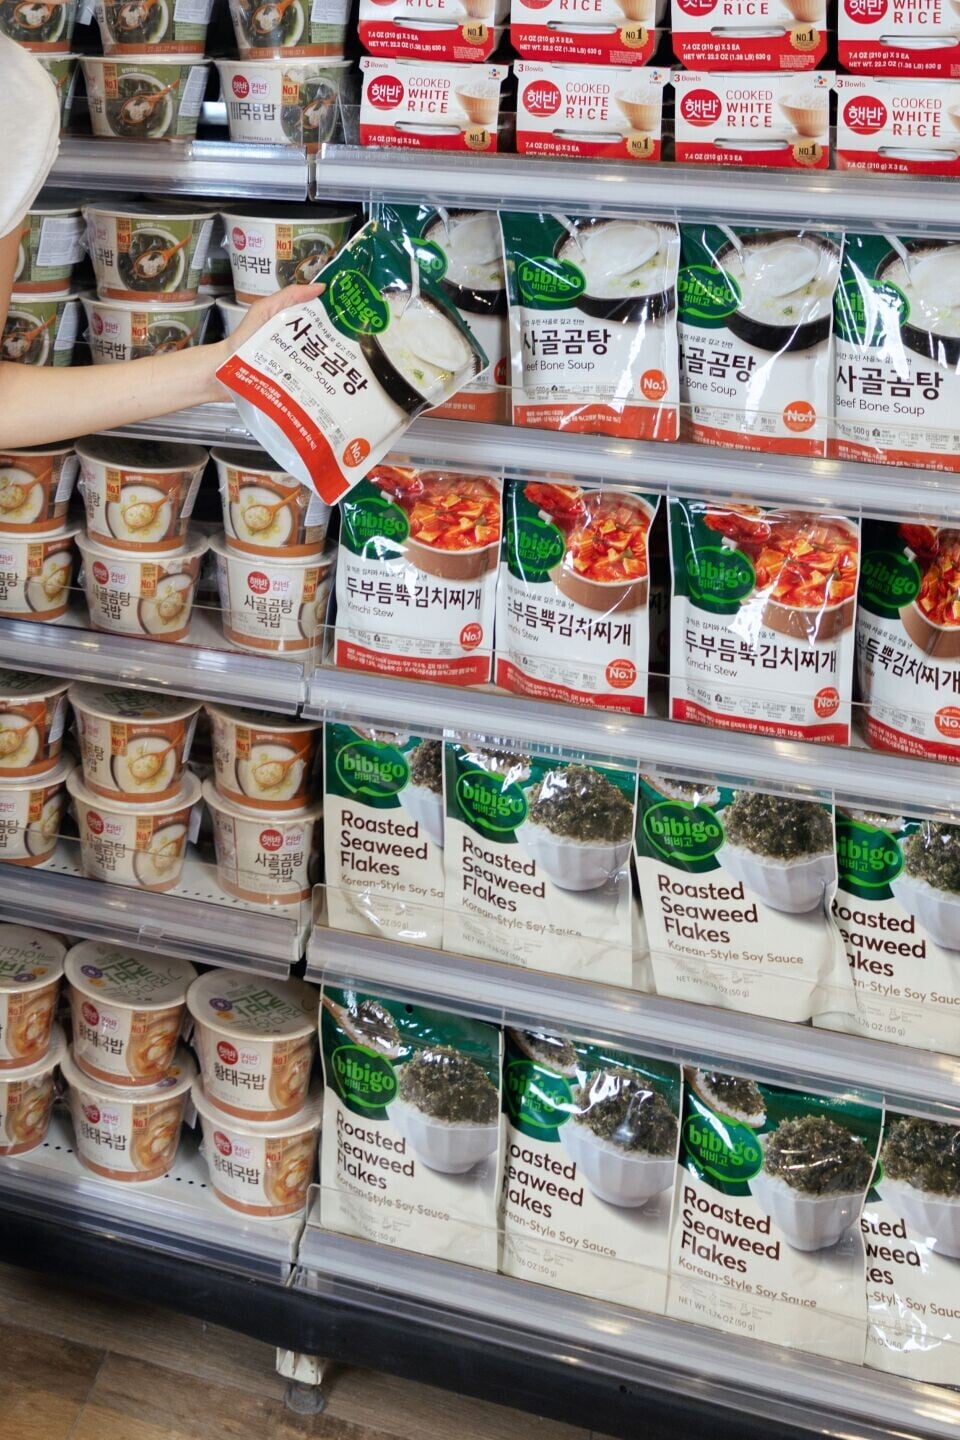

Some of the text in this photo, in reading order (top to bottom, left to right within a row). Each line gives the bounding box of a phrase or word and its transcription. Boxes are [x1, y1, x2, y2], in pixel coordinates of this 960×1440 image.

[724, 3, 768, 15] RICE
[522, 268, 581, 292] bibigo
[531, 282, 557, 293] 비비고
[339, 292, 358, 318] 비비고
[340, 274, 383, 328] bibigo
[286, 316, 368, 396] 사골곰탕
[524, 329, 611, 356] 사골곰탕
[270, 332, 337, 396] Beef Bone Soup
[524, 360, 595, 372] eef Bone Soup
[643, 378, 666, 392] No.1
[688, 379, 737, 396] Bone Soup
[837, 364, 944, 400] 사골곰탕
[859, 399, 890, 414] Bone
[893, 402, 926, 418] Soup
[688, 558, 750, 588] bibigo
[862, 560, 916, 596] bibigo
[244, 595, 294, 614] 사골곰탕
[346, 576, 481, 610] 두부듬뿍김치찌개
[347, 602, 394, 618] Kimchi Stew
[508, 597, 632, 646] 부듬뿍김치찌개
[463, 631, 481, 642] No.1
[685, 629, 838, 674] 두부듬뿍김치찌개
[609, 668, 634, 680] No.1
[686, 656, 738, 678] Kimchi Stew
[344, 754, 404, 782] bibigo
[354, 772, 380, 784] 비비고
[463, 785, 524, 816] bibigo
[472, 802, 497, 818] 비비고
[342, 810, 418, 839] Roasted
[650, 815, 720, 843] bibigo
[340, 830, 428, 860] Seaweed
[463, 836, 536, 877] Roasted
[664, 836, 694, 848] 비비고
[342, 851, 400, 876] Flakes
[462, 856, 546, 898] Seaweed
[342, 874, 426, 896] Korean-Style Soy
[463, 875, 517, 913] Flakes
[658, 874, 744, 900] Roasted
[462, 898, 582, 937] Korean-Style Soy Sauce
[660, 895, 758, 923] Seaweed
[831, 899, 915, 934] Roasted
[664, 916, 730, 944] Flakes
[840, 928, 926, 959] eaweed
[668, 939, 804, 964] Korean-Style Soy Sauce
[904, 988, 960, 1006] Soy Sauc
[214, 1062, 267, 1090] 황태국밥
[337, 1056, 394, 1092] bibigo
[337, 1110, 406, 1155] Roasted
[689, 1125, 758, 1165] bibigo
[337, 1130, 414, 1178] Seaweed
[509, 1144, 576, 1180] oasted
[337, 1150, 387, 1190] Flakes
[337, 1173, 450, 1221] Korean-Style Soy Sauce
[506, 1164, 584, 1207] eaweed
[684, 1186, 770, 1235] Roasted
[560, 1231, 616, 1258] Soy Sauce
[683, 1209, 780, 1260] Seaweed
[682, 1231, 747, 1274] Flakes
[678, 1256, 817, 1308] Korean-Style Soy Sauce
[905, 1297, 927, 1314] Soy
[930, 1304, 960, 1319] Sauc
